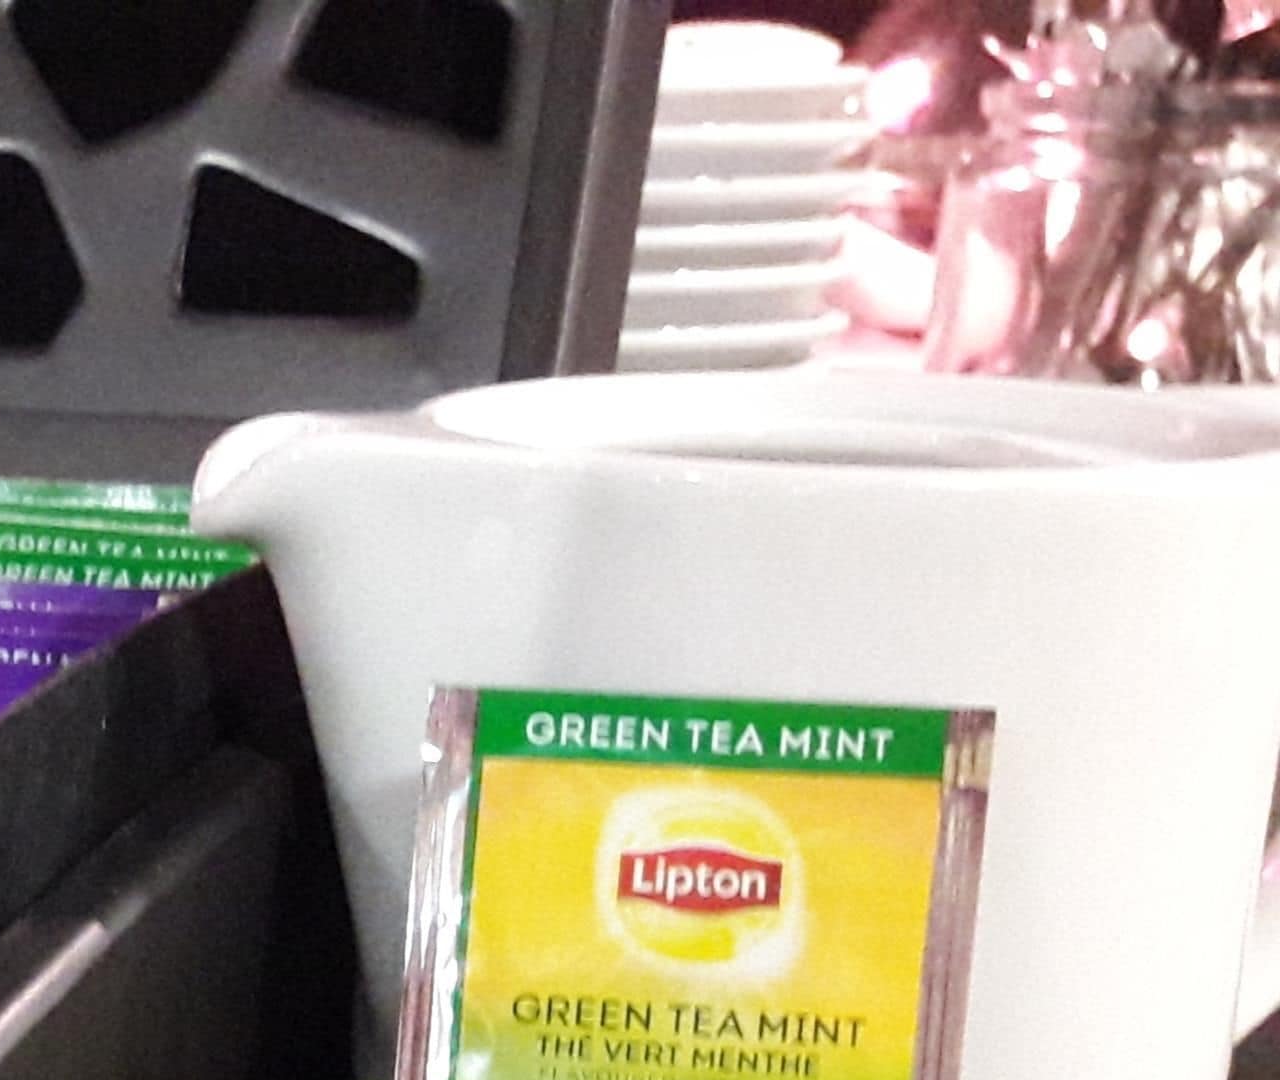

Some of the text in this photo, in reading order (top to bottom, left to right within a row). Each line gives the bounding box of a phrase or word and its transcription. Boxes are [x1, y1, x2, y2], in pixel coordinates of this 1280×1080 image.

[526, 711, 895, 763] GREEN TEA MINT
[631, 856, 768, 903] Lipton
[511, 994, 867, 1049] GREEN TEA MINT
[604, 1038, 681, 1065] VERT
[691, 1046, 822, 1078] MENTHE
